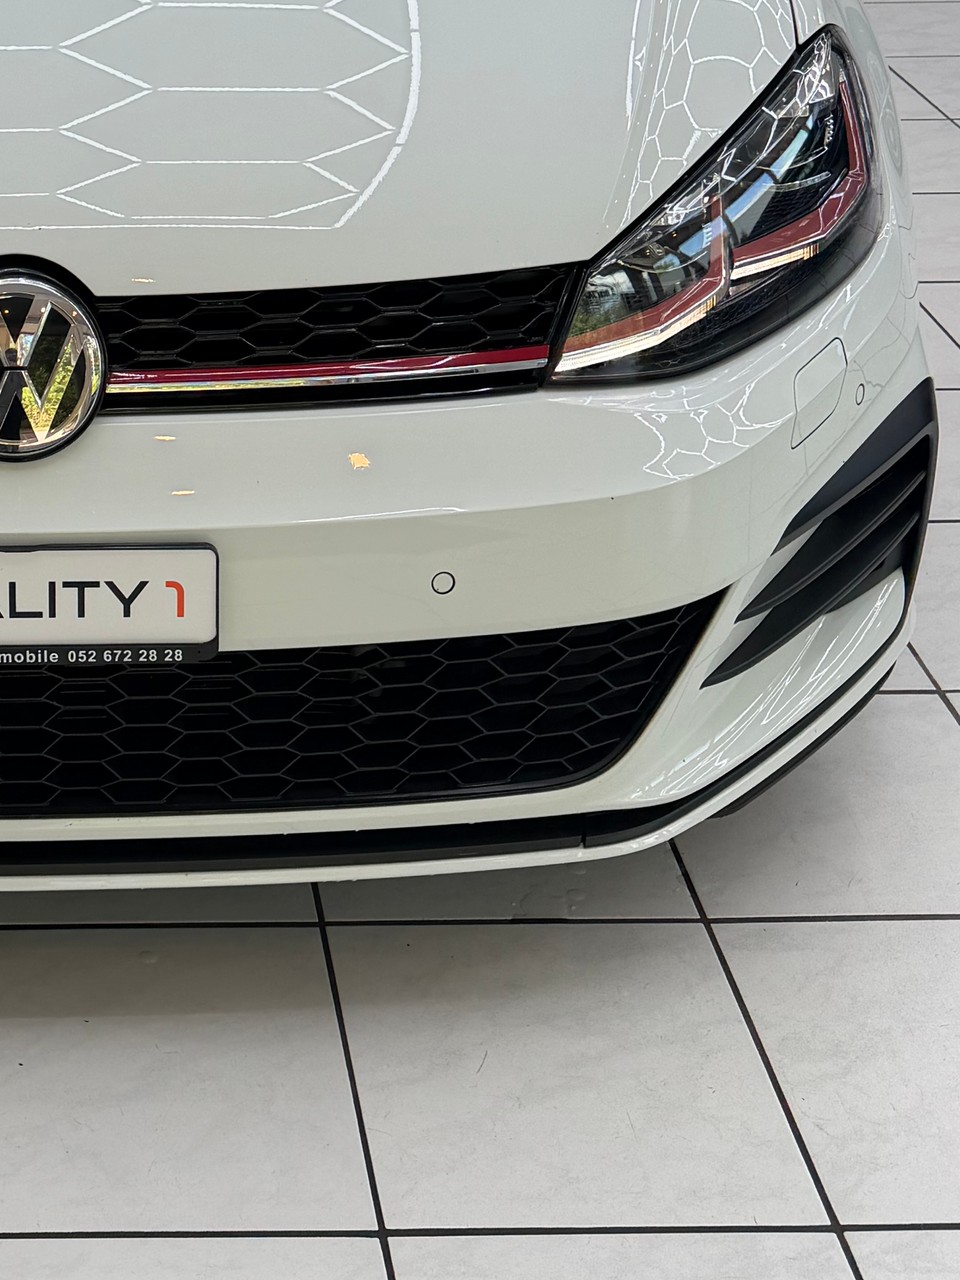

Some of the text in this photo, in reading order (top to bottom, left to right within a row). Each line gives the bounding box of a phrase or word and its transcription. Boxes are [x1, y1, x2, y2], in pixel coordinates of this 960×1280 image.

[165, 580, 185, 618] 1
[67, 650, 97, 663] 052
[103, 649, 133, 662] 672
[138, 649, 158, 662] 28
[164, 649, 183, 662] 28
